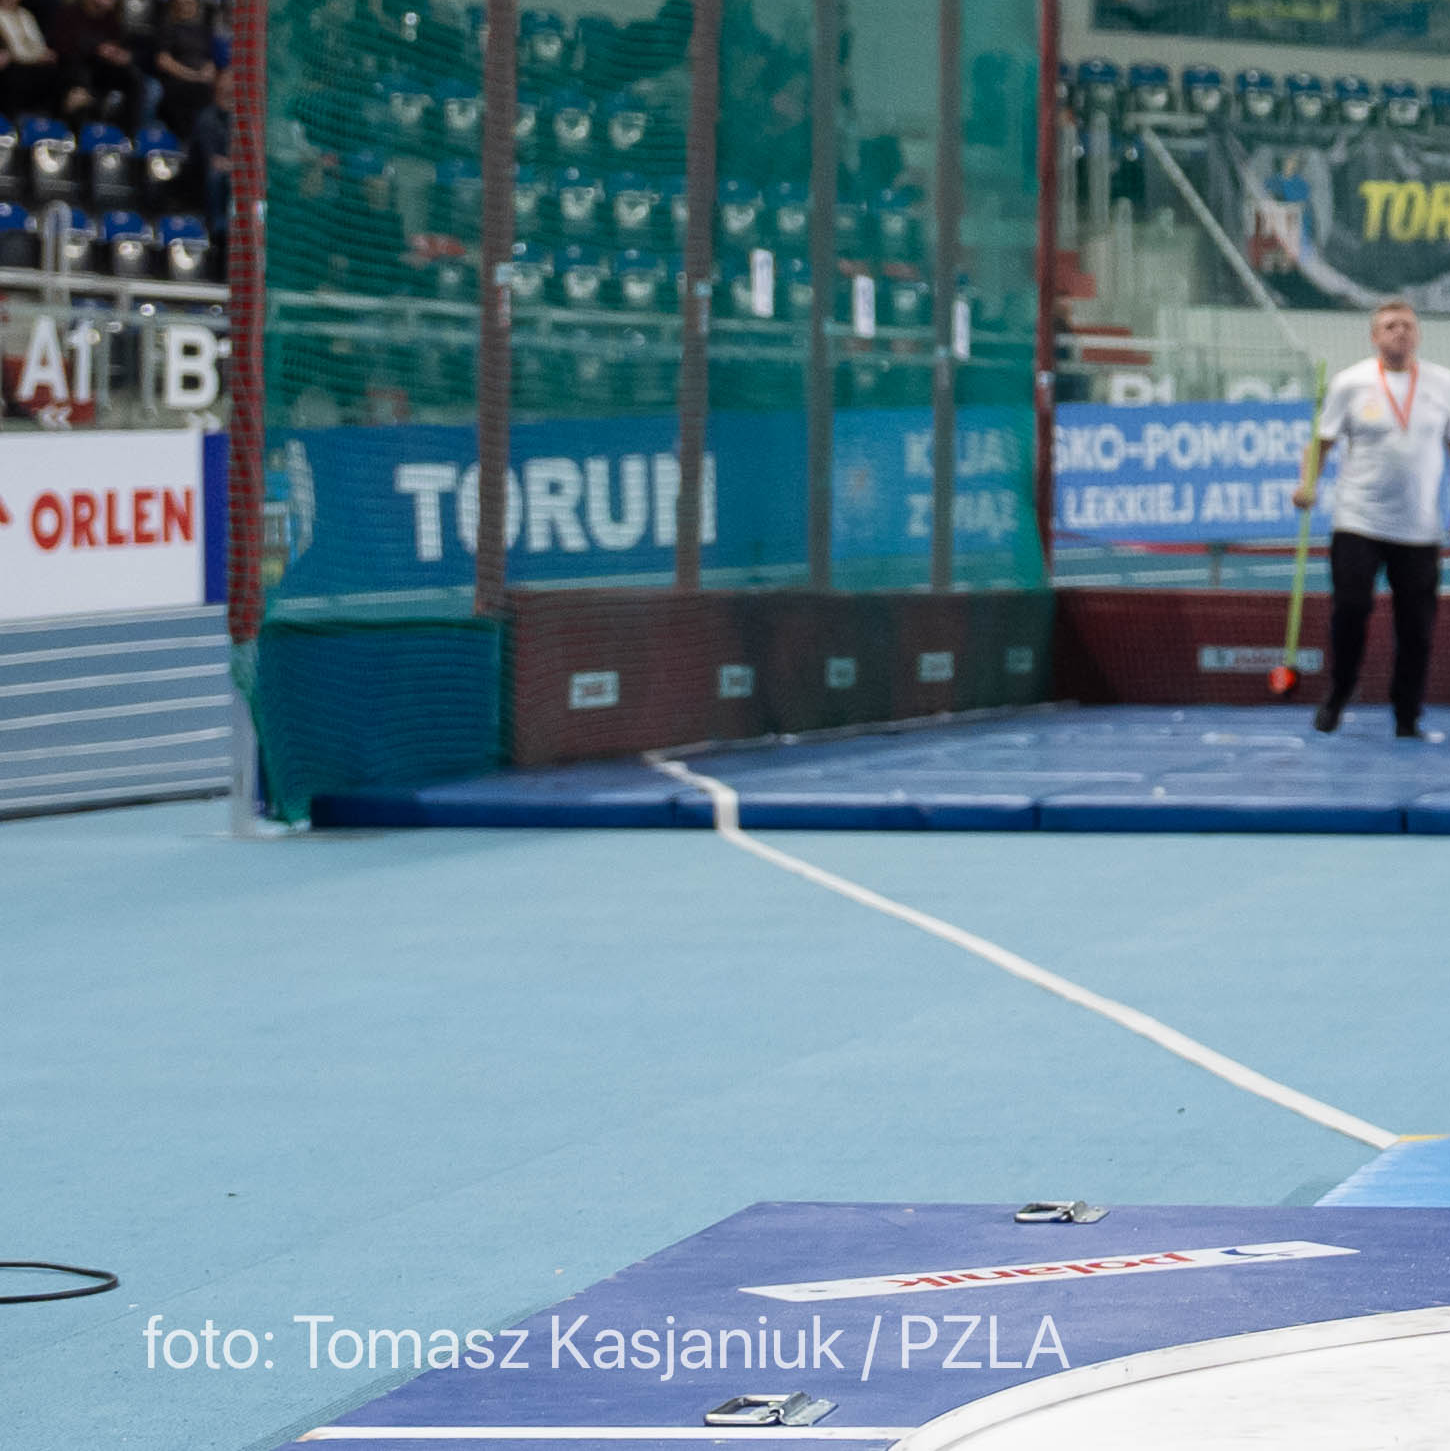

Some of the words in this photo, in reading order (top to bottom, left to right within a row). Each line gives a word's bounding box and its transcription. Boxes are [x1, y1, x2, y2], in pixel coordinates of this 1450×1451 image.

[17, 315, 94, 401] A1
[31, 485, 194, 551] ORLEN
[883, 1253, 1195, 1287] polanik
